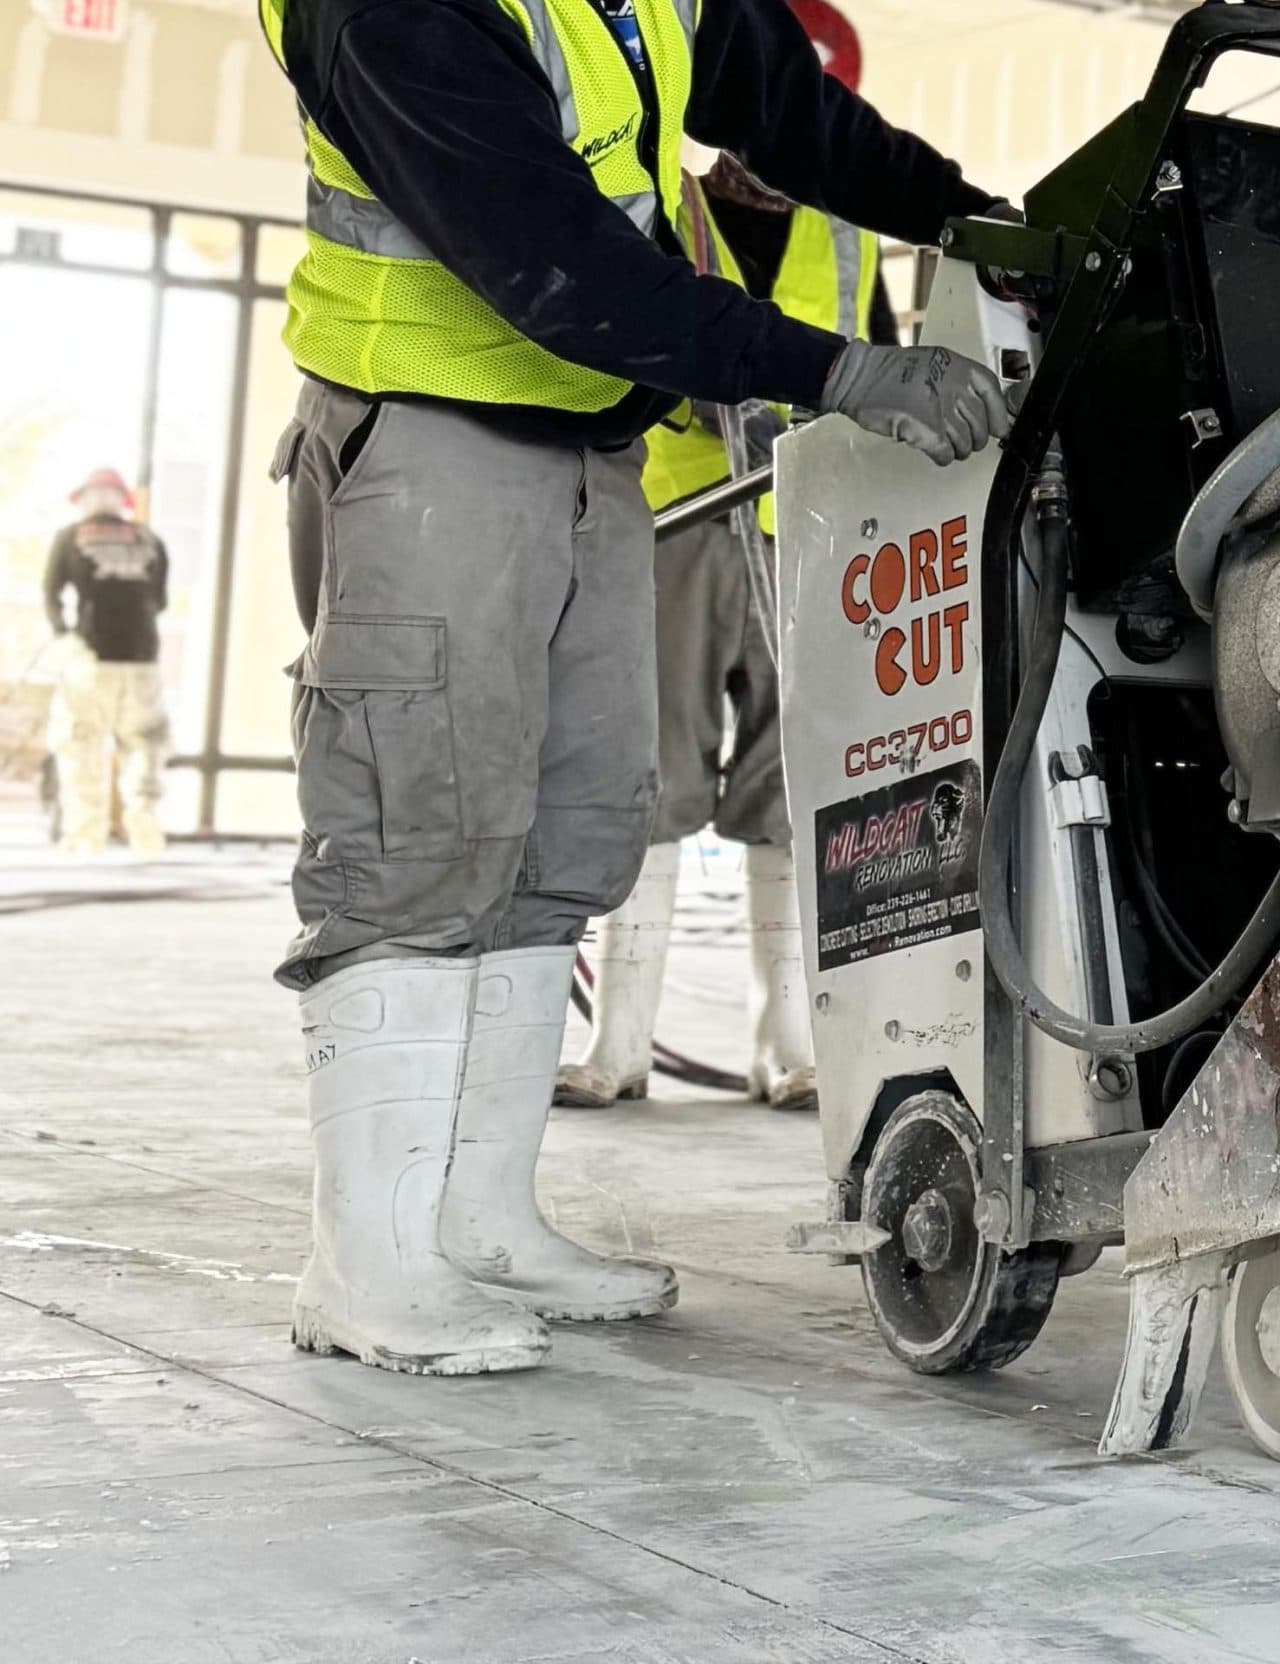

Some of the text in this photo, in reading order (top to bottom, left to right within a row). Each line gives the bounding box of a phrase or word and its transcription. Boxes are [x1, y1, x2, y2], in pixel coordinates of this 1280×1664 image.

[841, 514, 968, 625] CORE
[875, 601, 969, 696] CUT
[845, 709, 972, 777] CC3700
[825, 800, 930, 871] WILDCAT
[856, 848, 932, 890] RENOVATION
